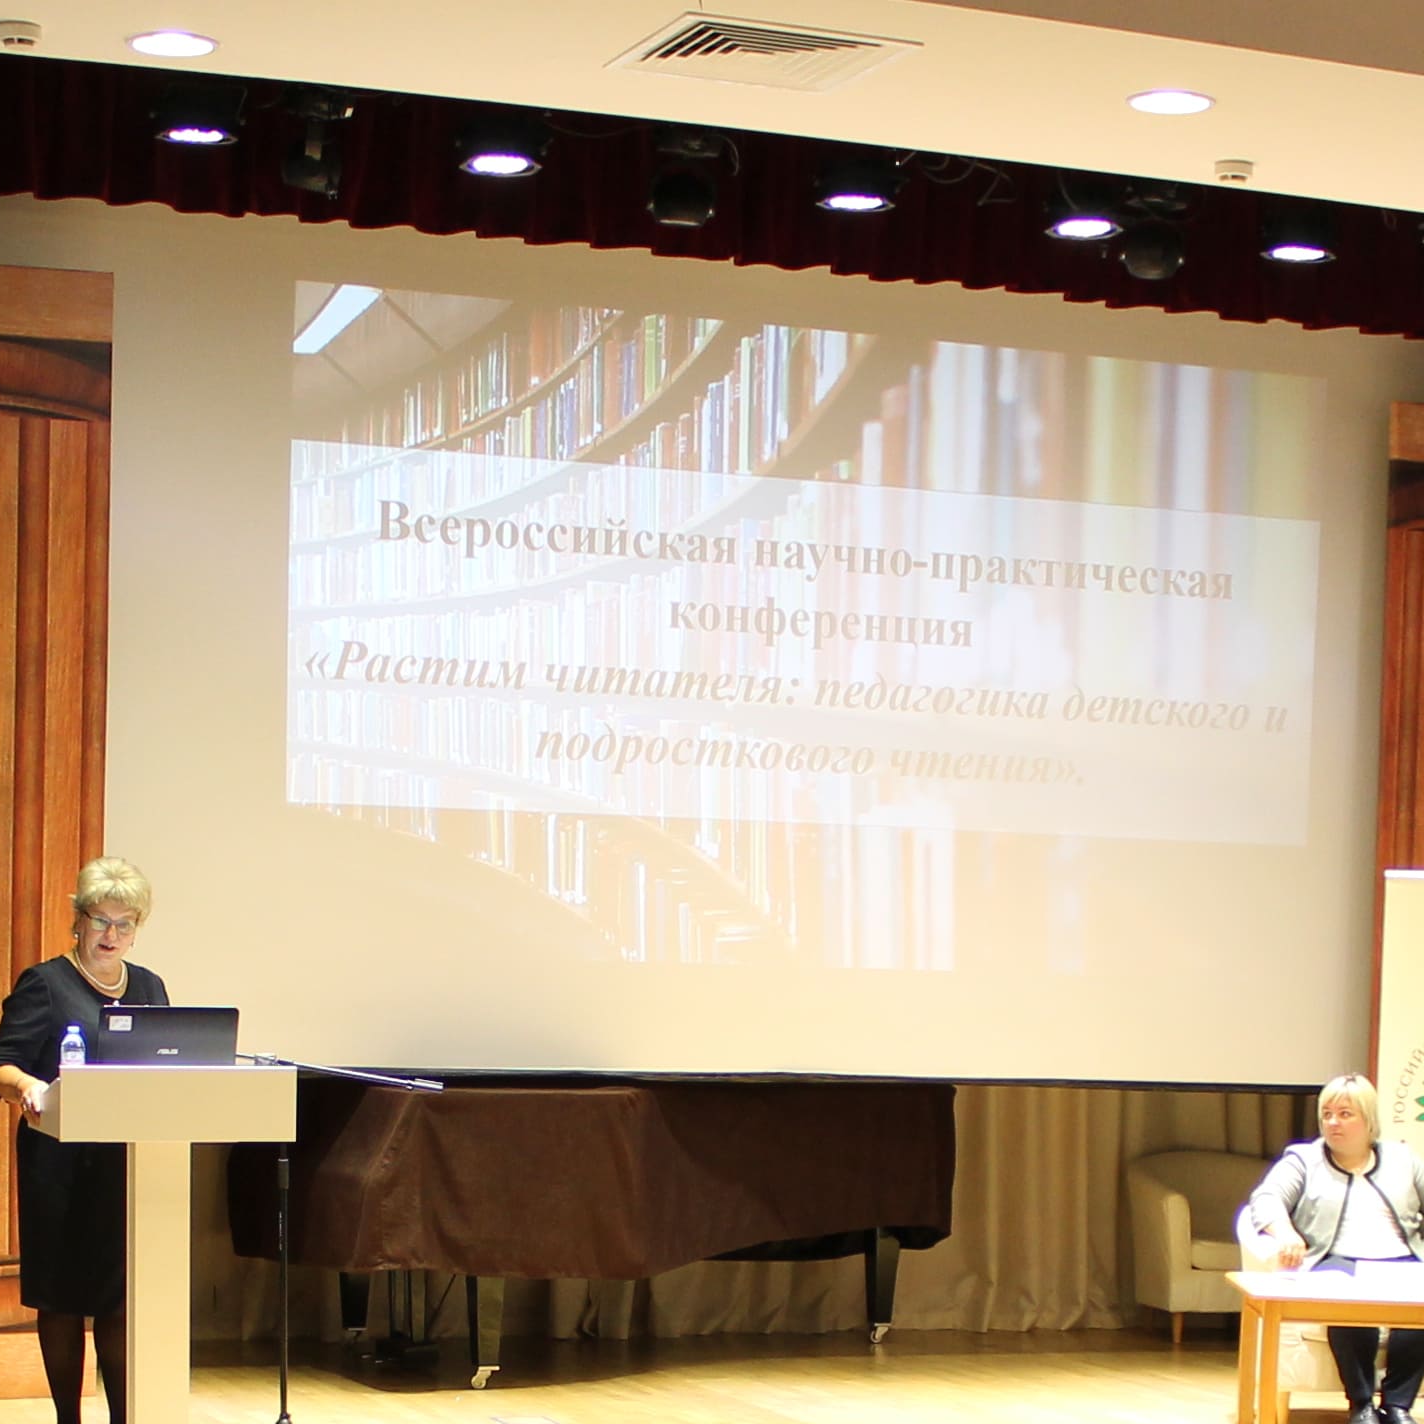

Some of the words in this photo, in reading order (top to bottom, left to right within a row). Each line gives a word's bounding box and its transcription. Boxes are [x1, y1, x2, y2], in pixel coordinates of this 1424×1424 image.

[378, 499, 736, 565] Всероссийская
[754, 538, 1234, 601] научно-практическая
[669, 597, 974, 650] конференция
[304, 638, 527, 690] «Растим
[544, 664, 801, 705] читателя:
[814, 673, 1049, 720] педагогика
[1062, 687, 1251, 731] детского
[1264, 705, 1289, 734] и
[535, 723, 875, 776] подросткового
[889, 745, 1085, 786] чтения».
